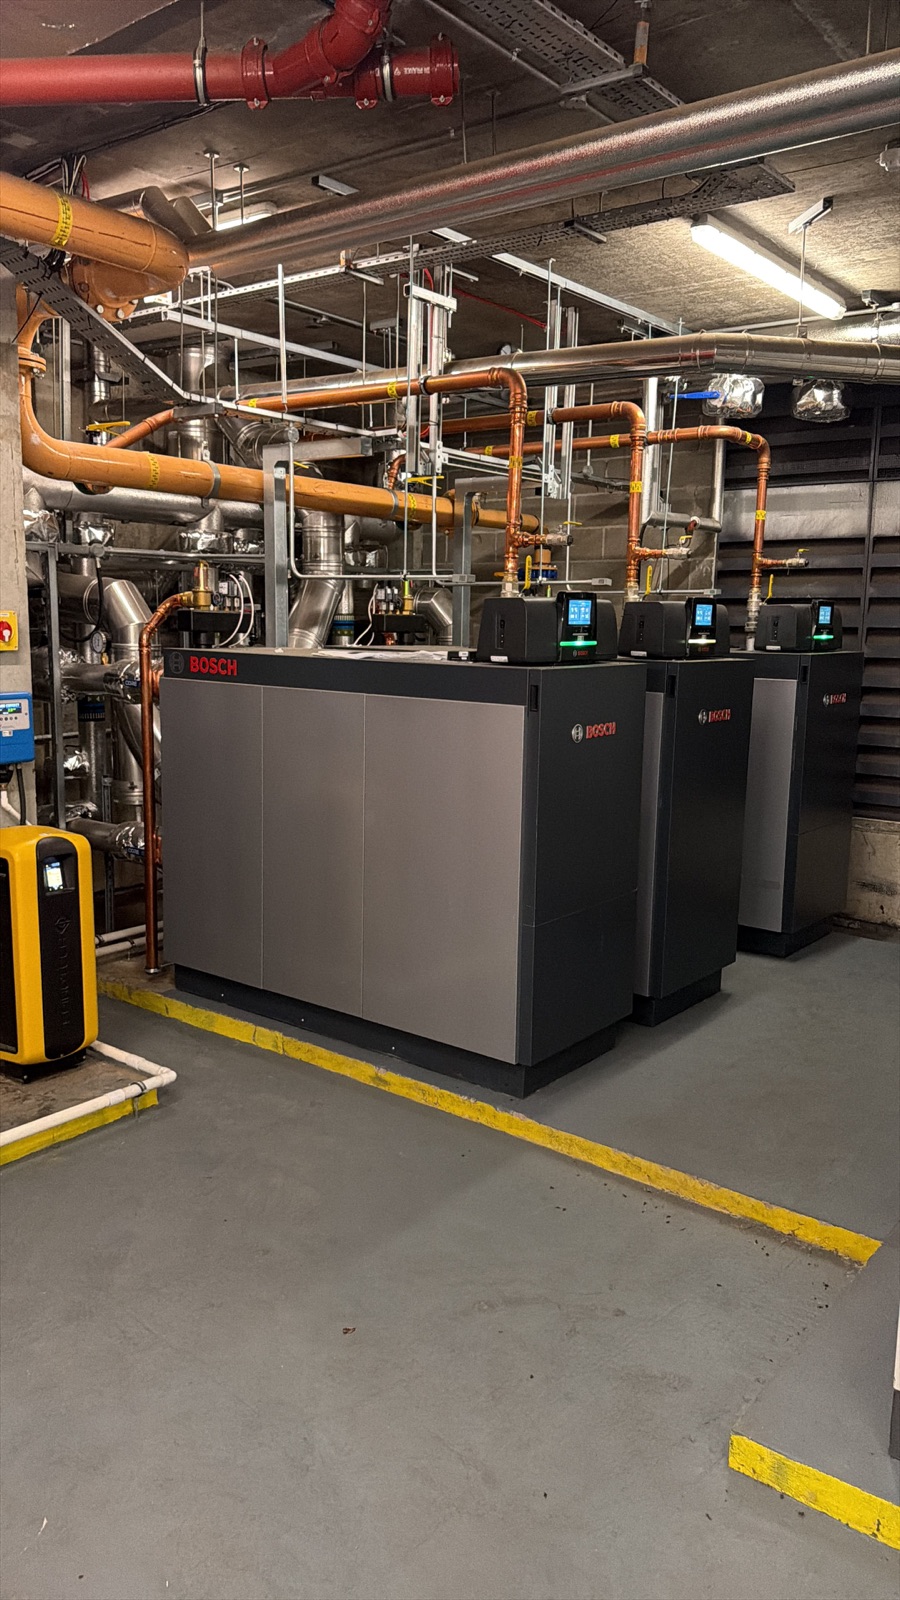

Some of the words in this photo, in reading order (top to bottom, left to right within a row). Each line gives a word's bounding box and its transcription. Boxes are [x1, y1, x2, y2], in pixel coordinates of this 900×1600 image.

[189, 655, 238, 676] BOSCH
[708, 708, 731, 723] BOSCH
[585, 721, 617, 739] BOSCH
